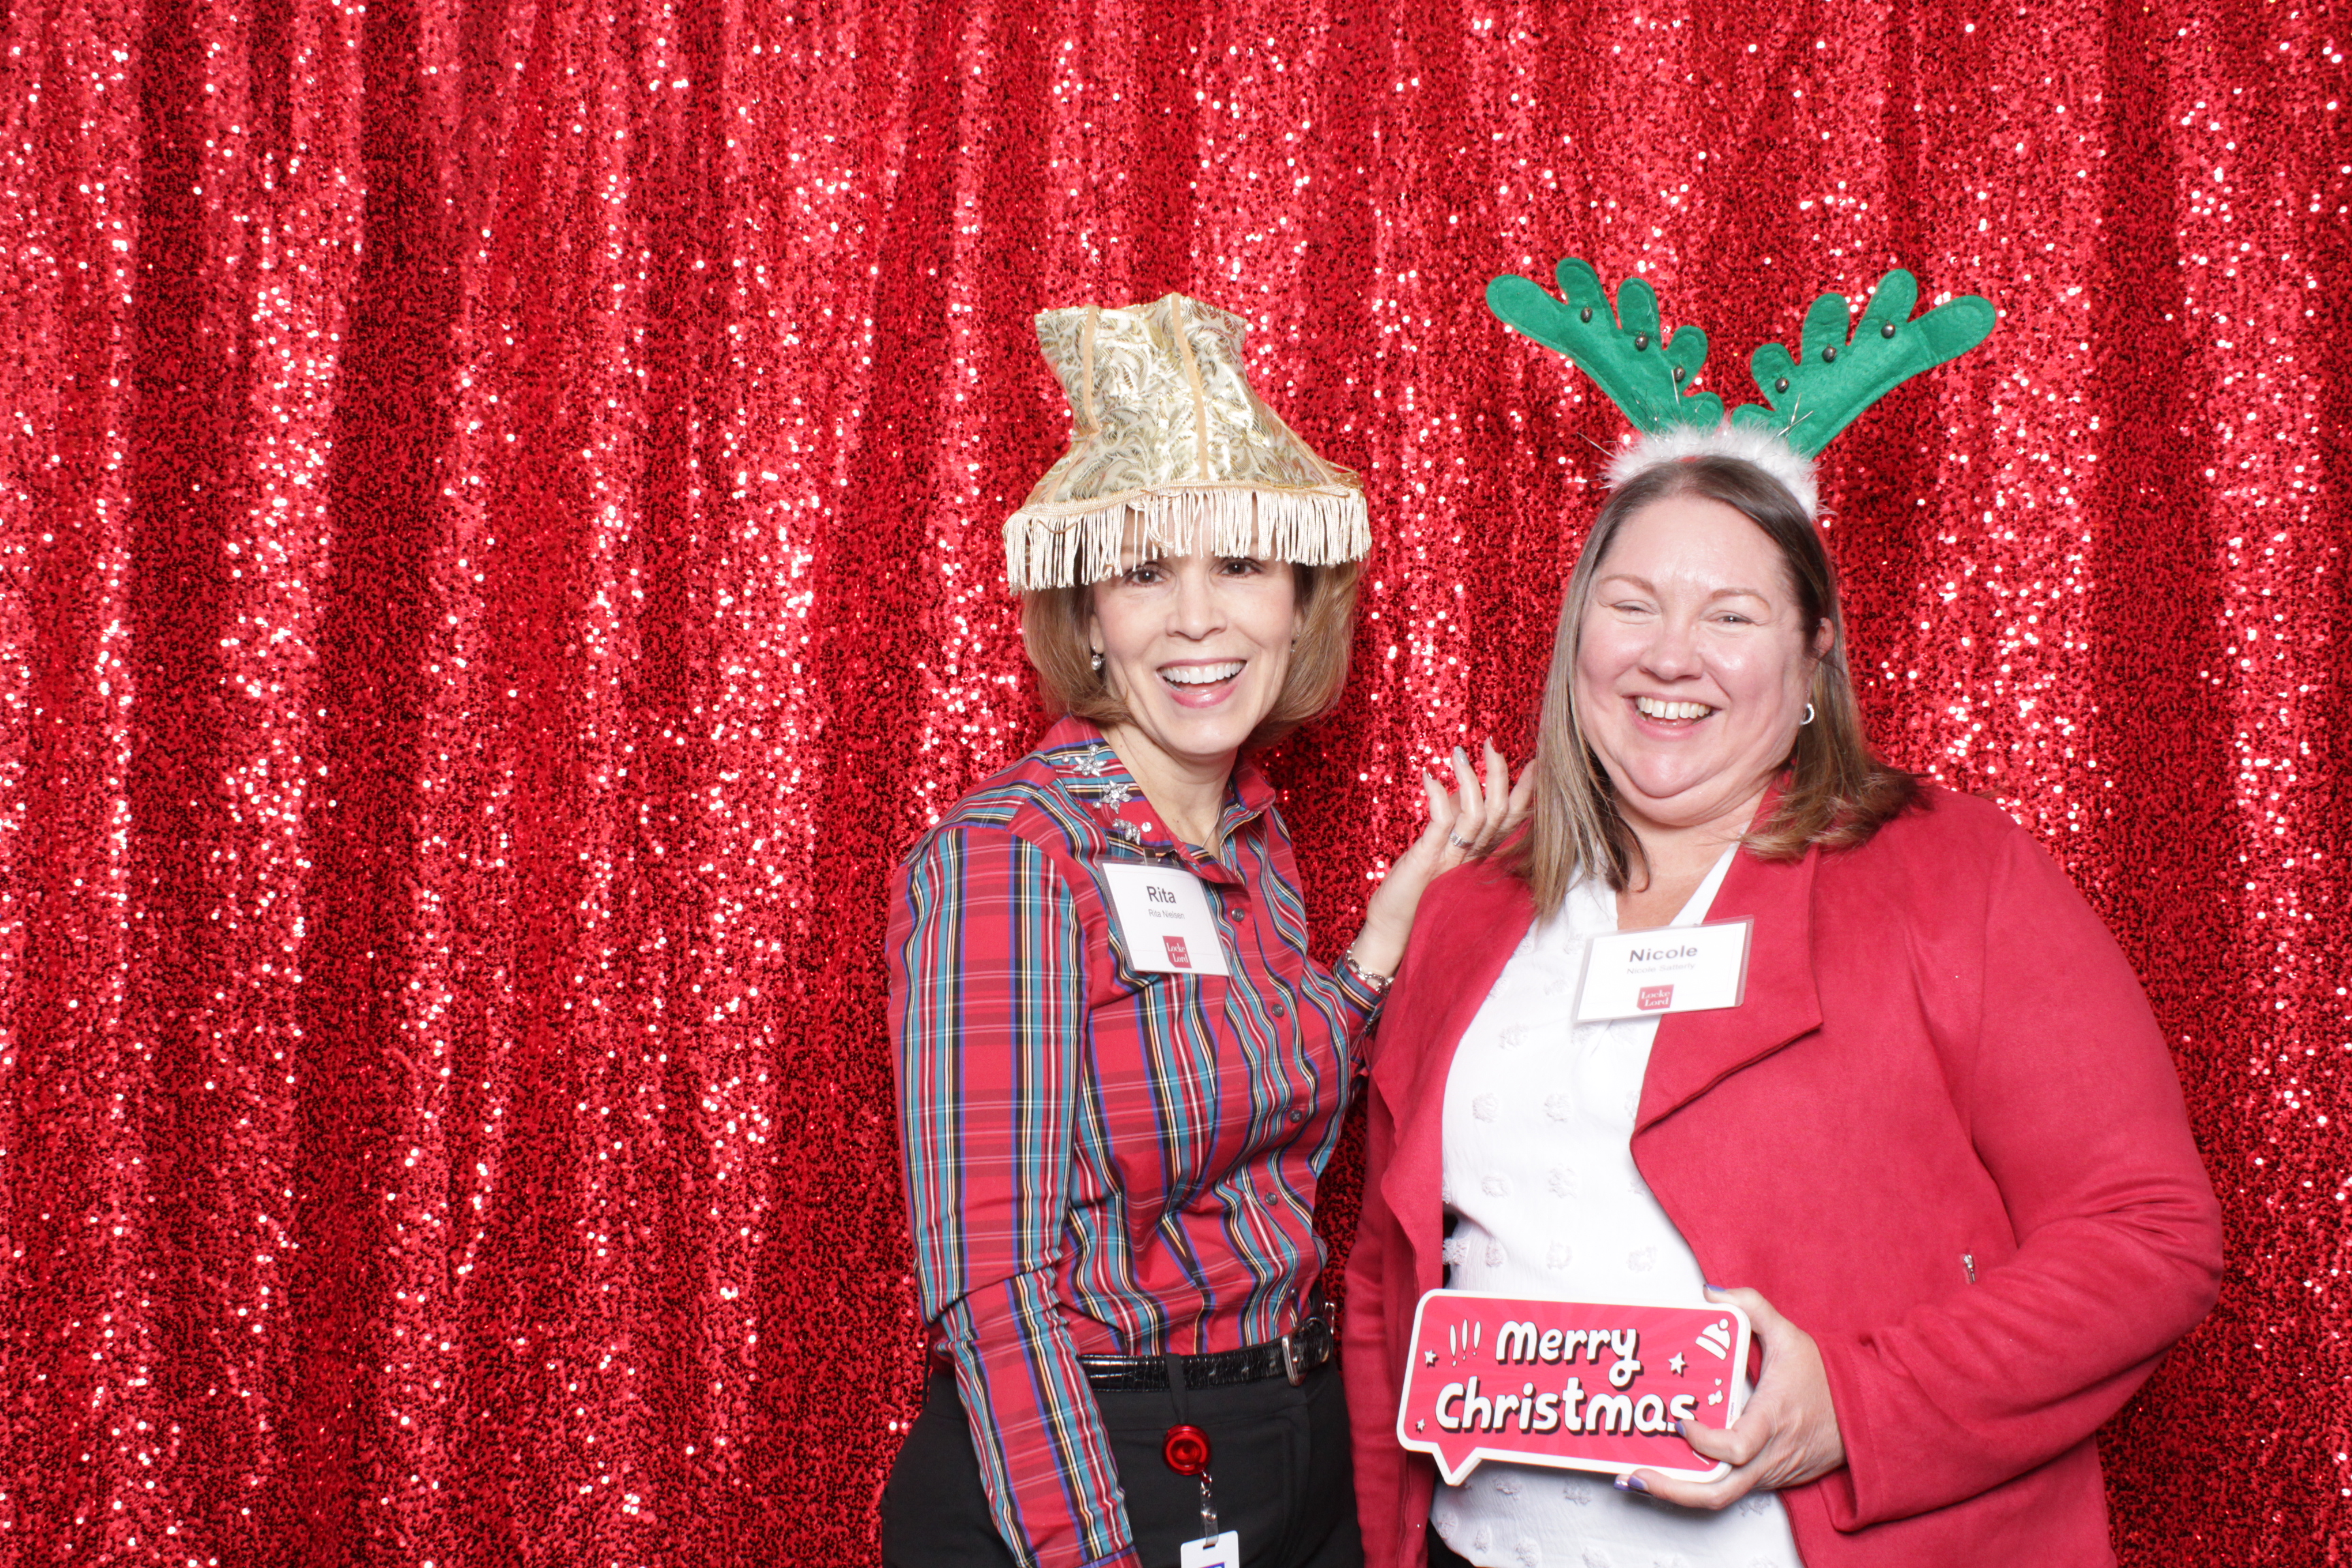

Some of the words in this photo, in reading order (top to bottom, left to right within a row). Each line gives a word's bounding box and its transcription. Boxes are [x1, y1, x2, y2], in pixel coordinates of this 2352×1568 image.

[1146, 885, 1177, 904] Rita
[1148, 909, 1162, 917] Rita
[1162, 910, 1186, 919] Nielsen
[1166, 943, 1186, 952] Locke
[1172, 953, 1189, 963] Lord
[1629, 945, 1698, 962] Nicole
[1627, 966, 1656, 975] Nicole
[1641, 989, 1671, 999] Locke
[1644, 996, 1669, 1007] Lord
[1495, 1320, 1642, 1387] Merry
[1435, 1375, 1697, 1434] Christmas
